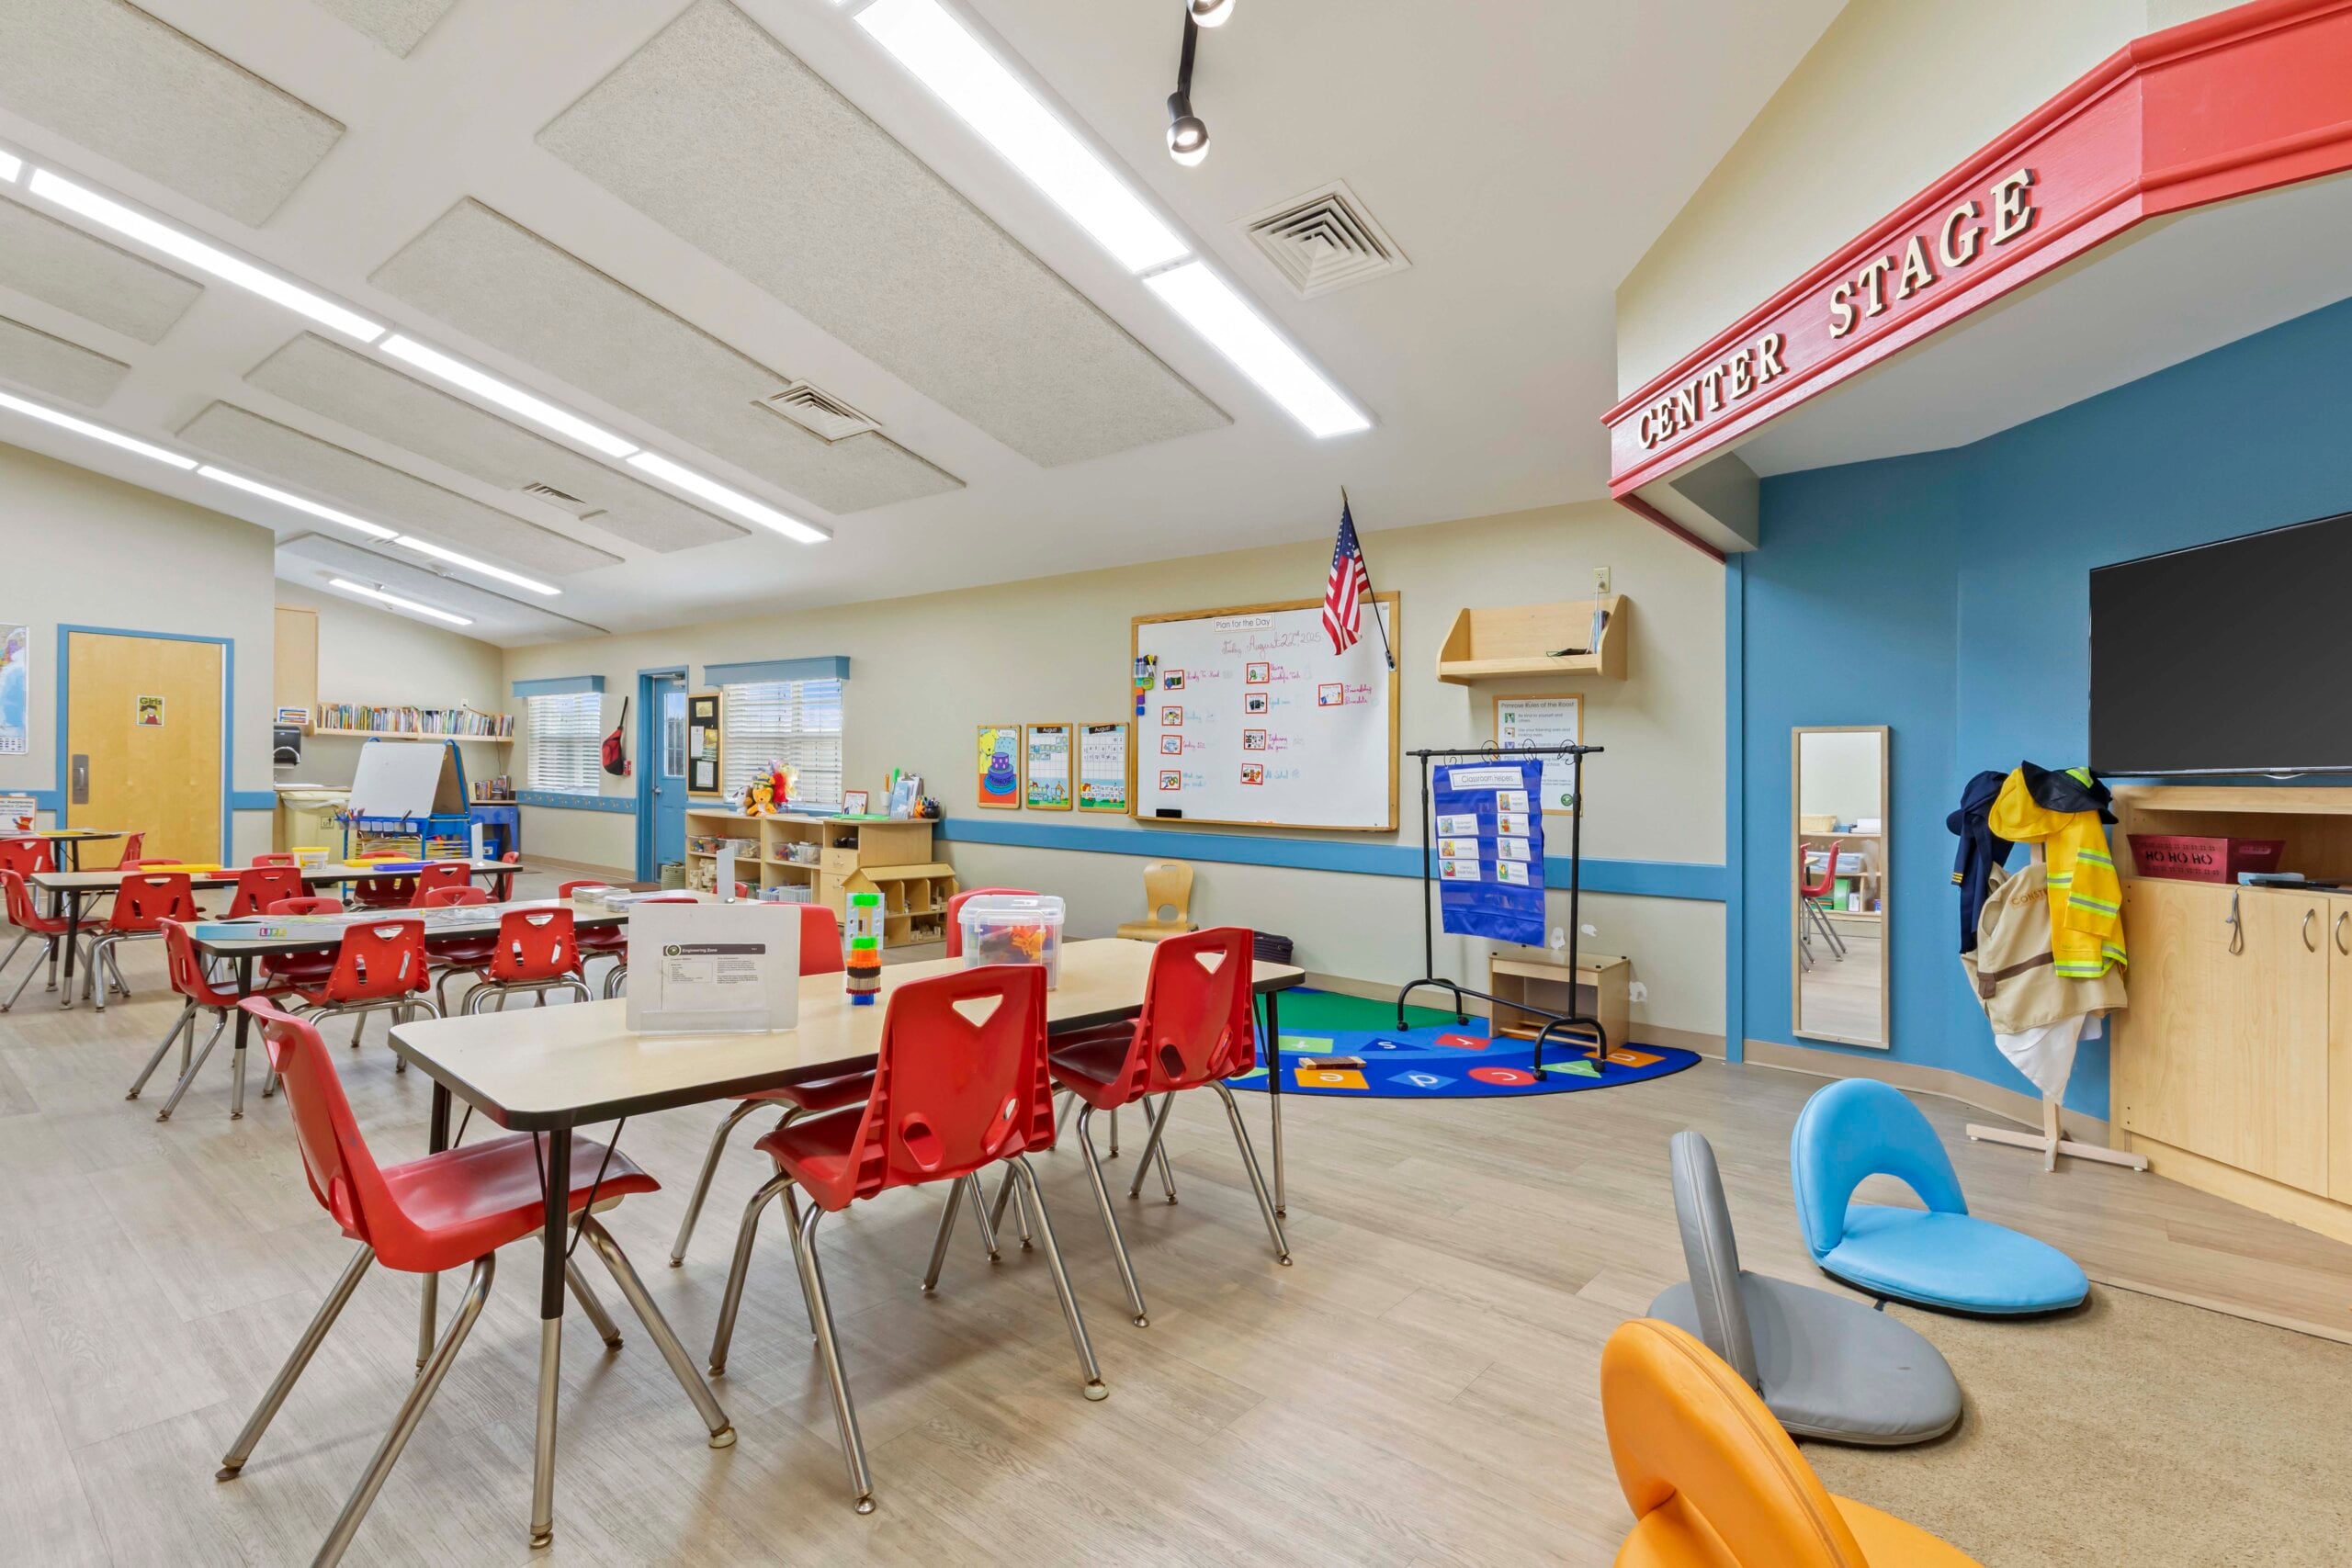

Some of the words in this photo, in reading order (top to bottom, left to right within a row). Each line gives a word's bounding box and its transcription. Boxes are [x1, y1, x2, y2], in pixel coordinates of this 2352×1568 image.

[1637, 332, 1785, 450] CENTER
[1828, 167, 2037, 340] STAGE
[1216, 621, 1231, 629] Plan
[1232, 620, 1241, 628] for
[1255, 617, 1271, 626] Day
[139, 697, 163, 705] Girls
[1461, 774, 1493, 784] Classroom
[1493, 774, 1514, 783] Helpers
[2145, 851, 2165, 863] HO
[2168, 852, 2188, 864] HO
[2192, 852, 2213, 865] HO
[1377, 1041, 1397, 1050] s
[1318, 1072, 1344, 1082] e
[1407, 1074, 1439, 1088] d
